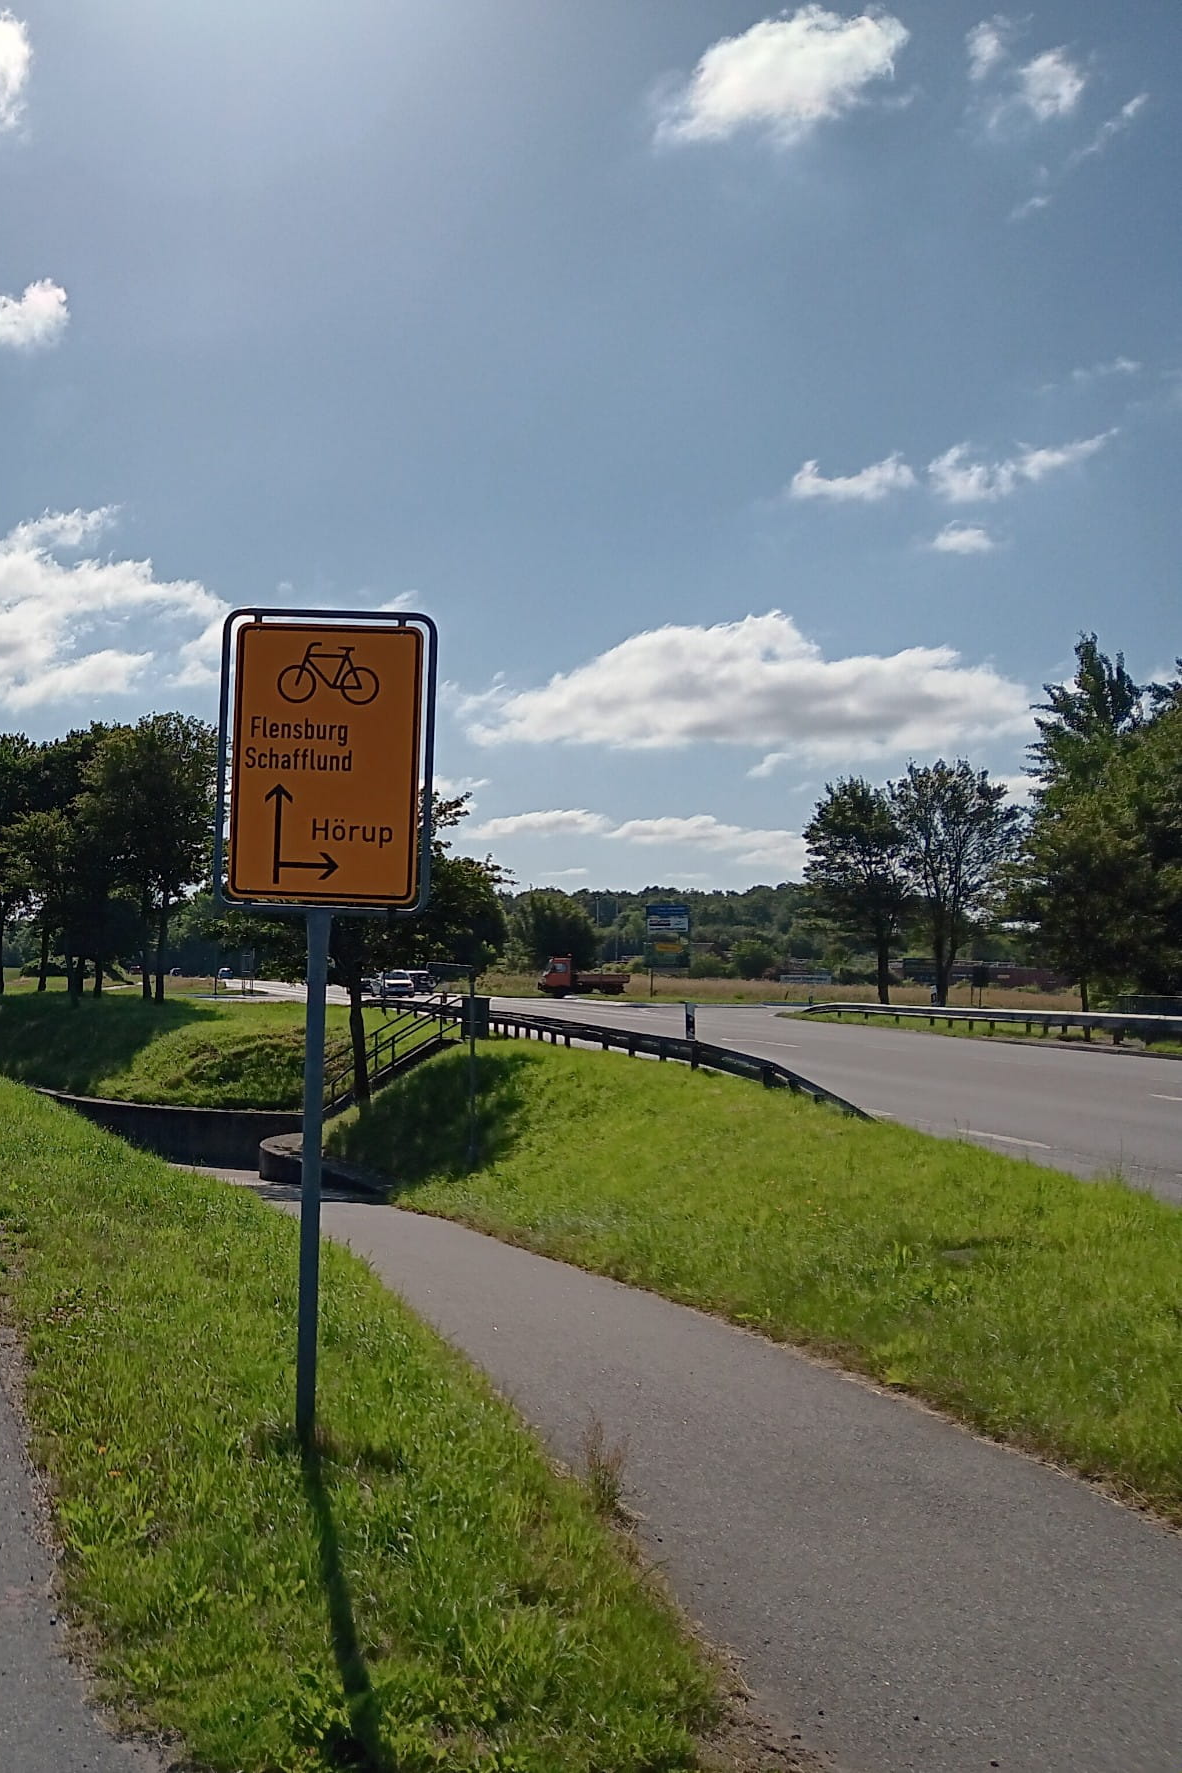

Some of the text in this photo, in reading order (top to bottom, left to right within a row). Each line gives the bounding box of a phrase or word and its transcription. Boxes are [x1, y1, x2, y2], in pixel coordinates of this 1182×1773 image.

[250, 716, 348, 746] Flensburg
[245, 747, 353, 772] Schafflund
[312, 818, 393, 848] Hörup
